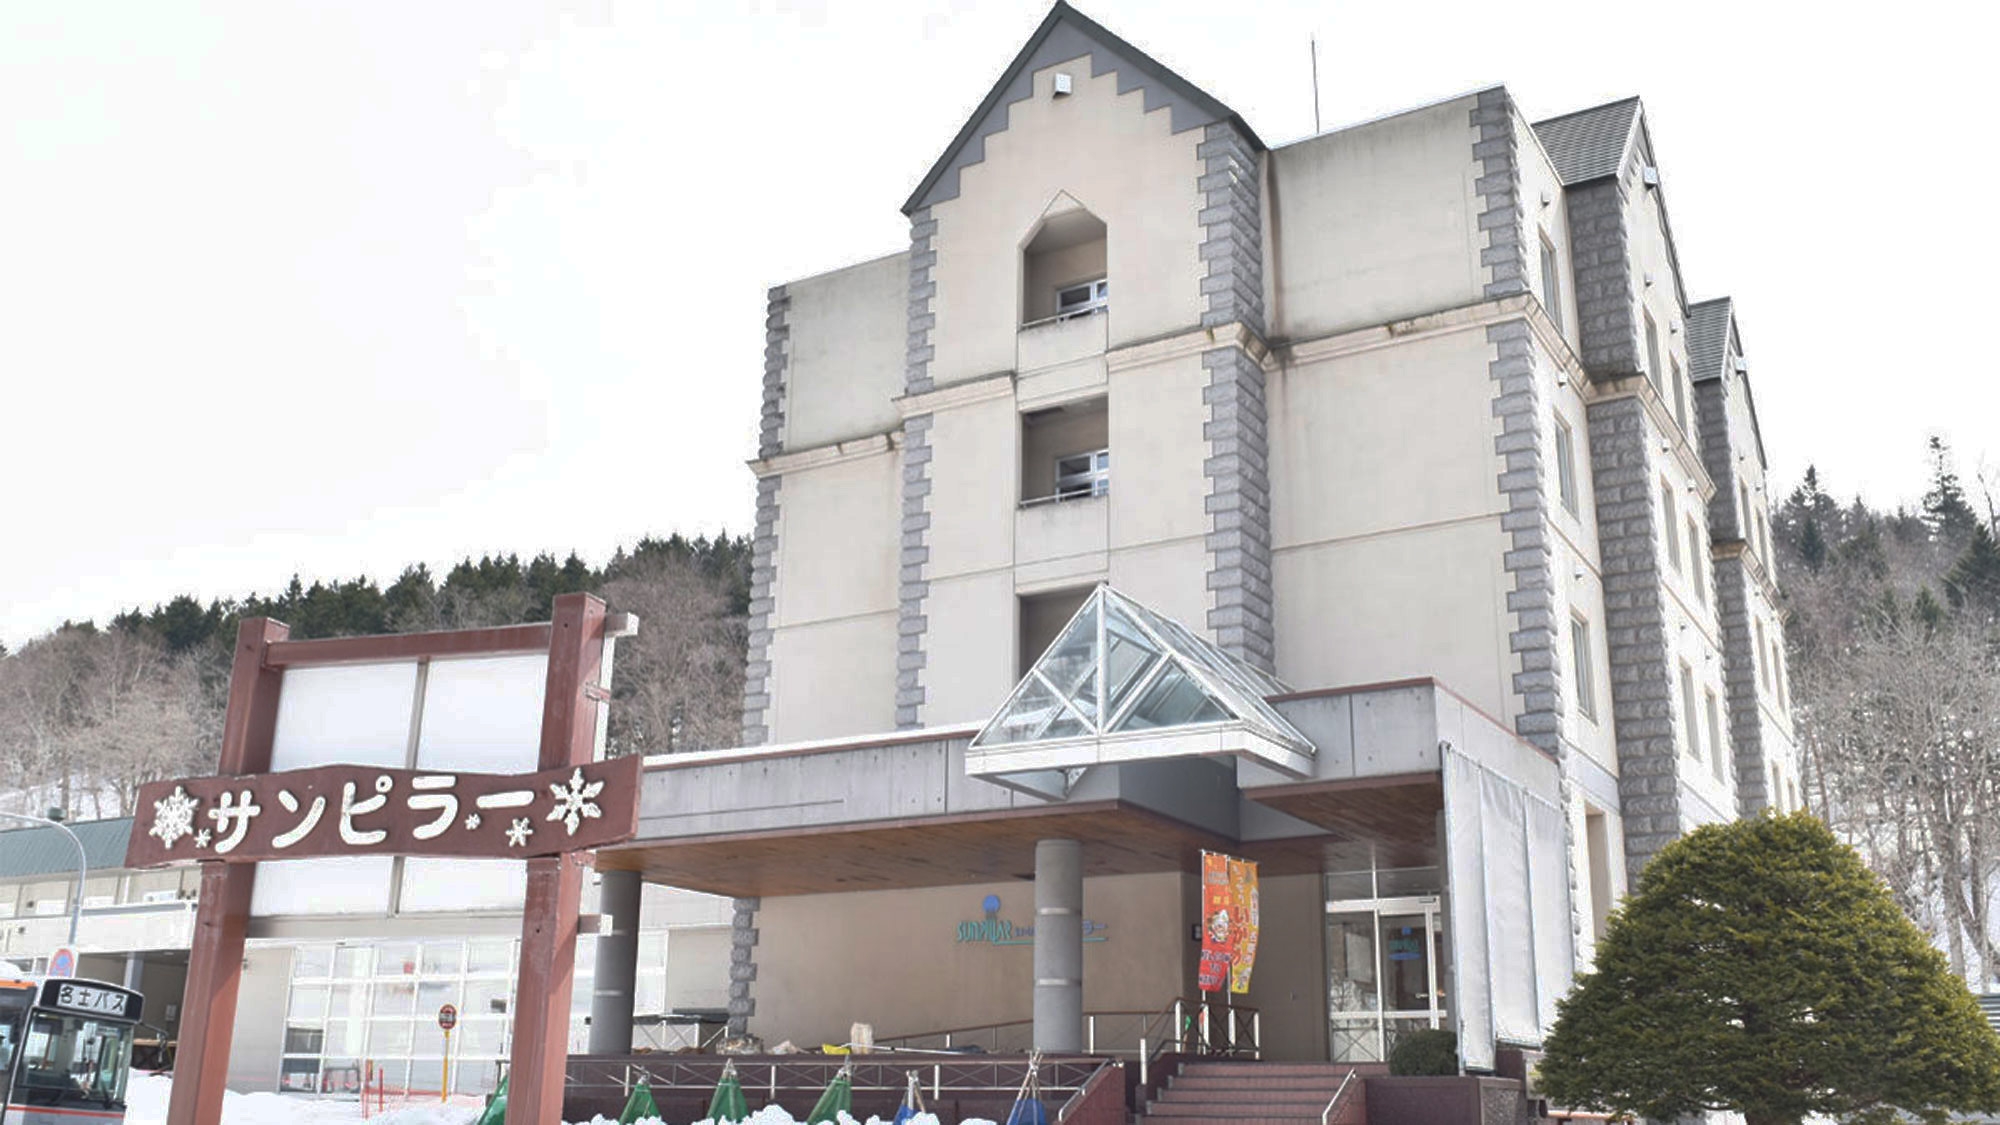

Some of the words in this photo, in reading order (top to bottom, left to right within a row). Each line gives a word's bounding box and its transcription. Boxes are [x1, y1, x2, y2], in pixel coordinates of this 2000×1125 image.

[208, 774, 535, 854] サンピラー
[60, 985, 125, 1012] 名士バス
